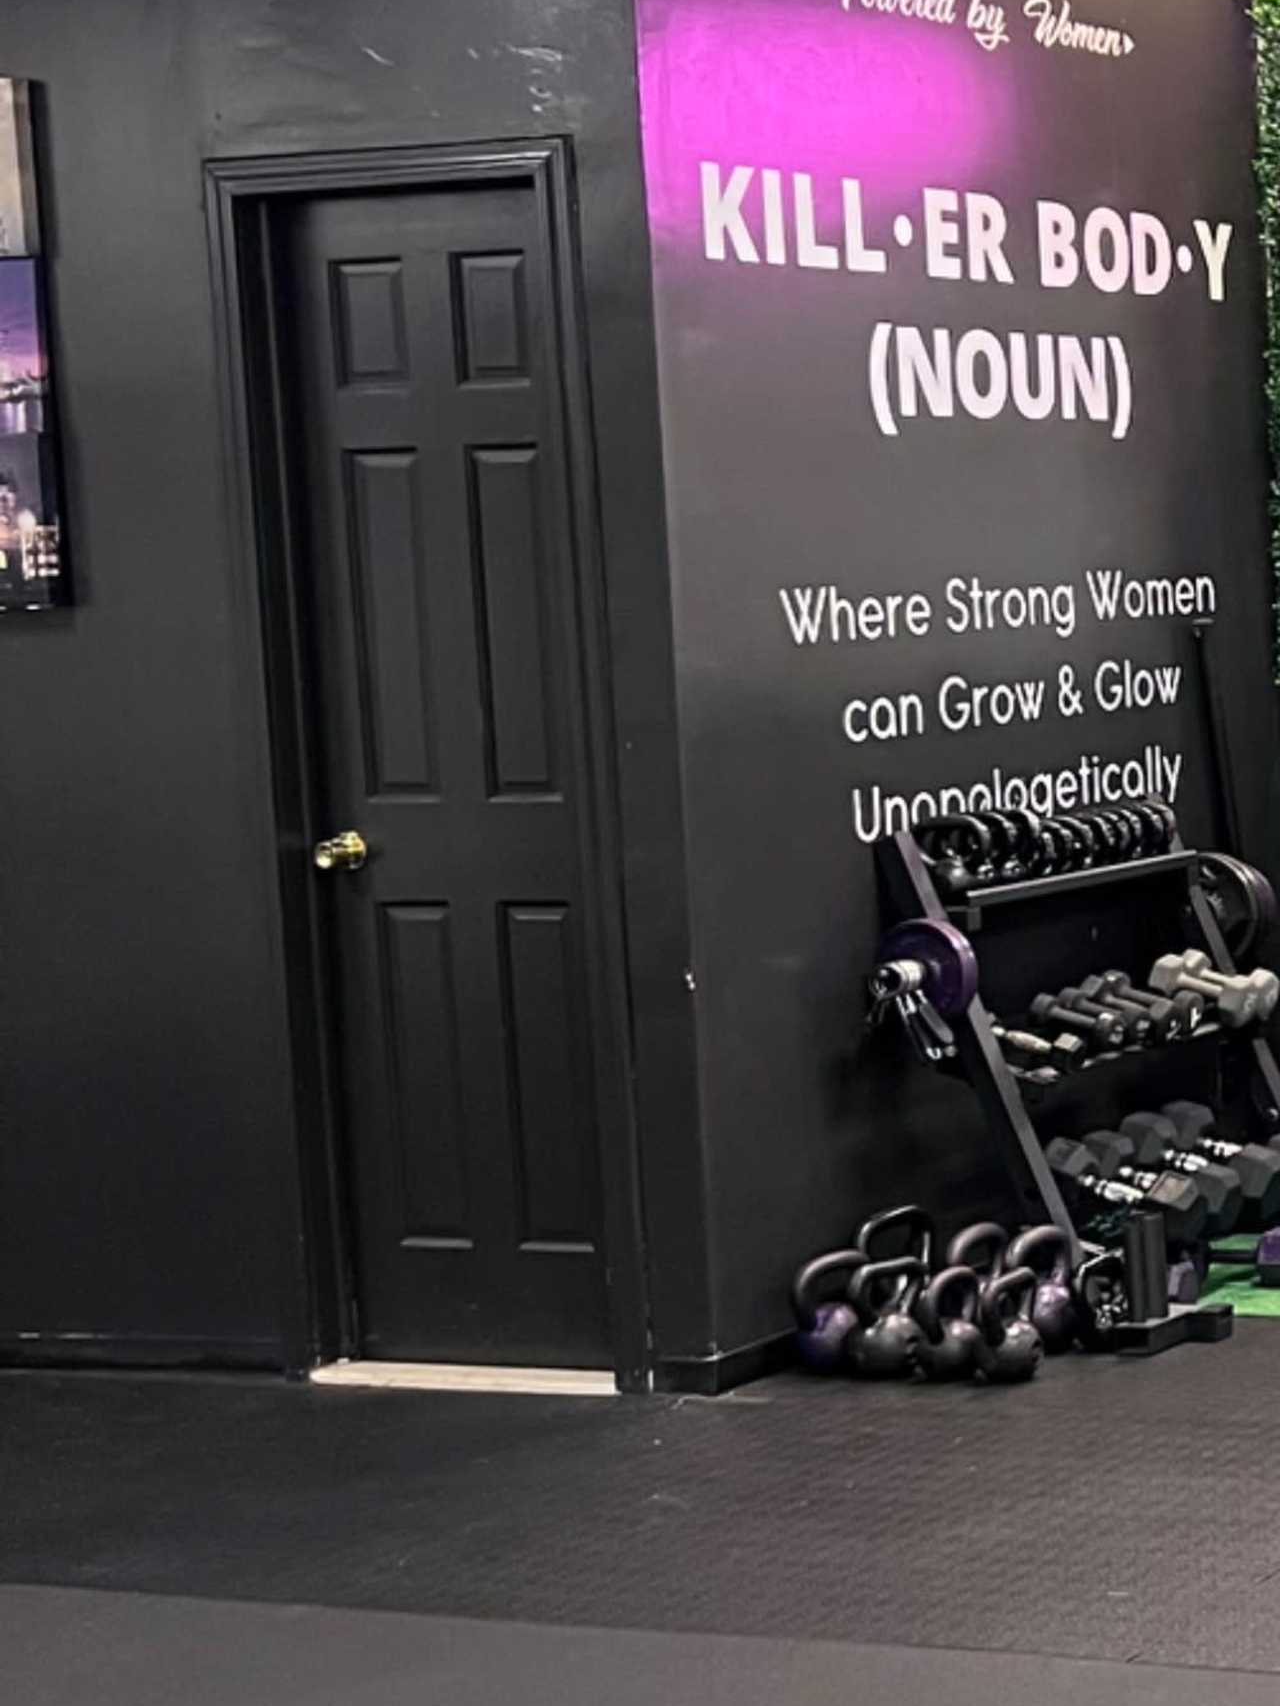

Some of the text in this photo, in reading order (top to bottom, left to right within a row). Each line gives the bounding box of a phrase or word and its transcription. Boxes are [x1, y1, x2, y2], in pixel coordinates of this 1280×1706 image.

[869, 322, 1132, 438] (NOUN)
[779, 570, 1216, 644] Where Strong Women
[843, 660, 1182, 742] can Grow & Glow
